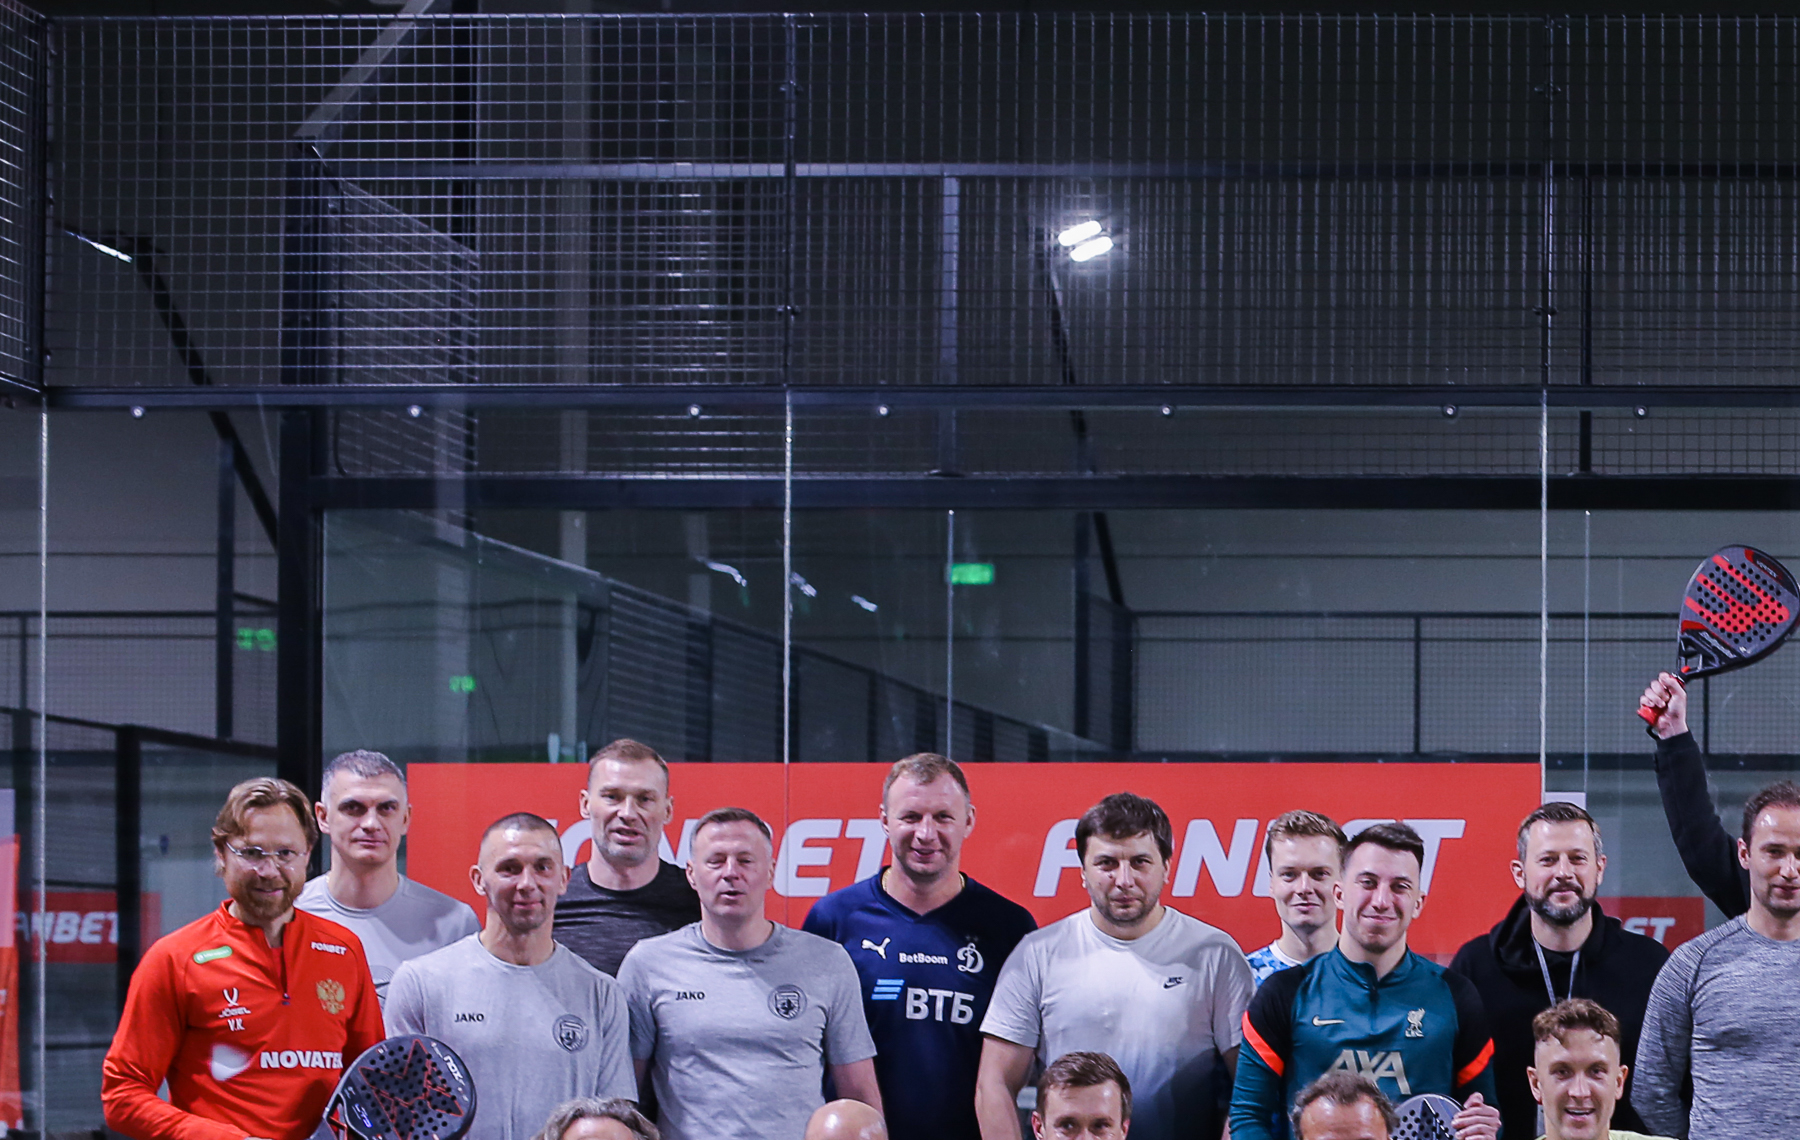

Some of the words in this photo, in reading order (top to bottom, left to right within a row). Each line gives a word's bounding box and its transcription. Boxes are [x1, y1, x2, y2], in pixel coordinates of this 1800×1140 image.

[311, 941, 347, 956] FONBET
[898, 952, 949, 965] BetBoom
[676, 990, 706, 1002] JAKO
[905, 986, 976, 1025] ВТБ
[454, 1012, 485, 1024] JAKO
